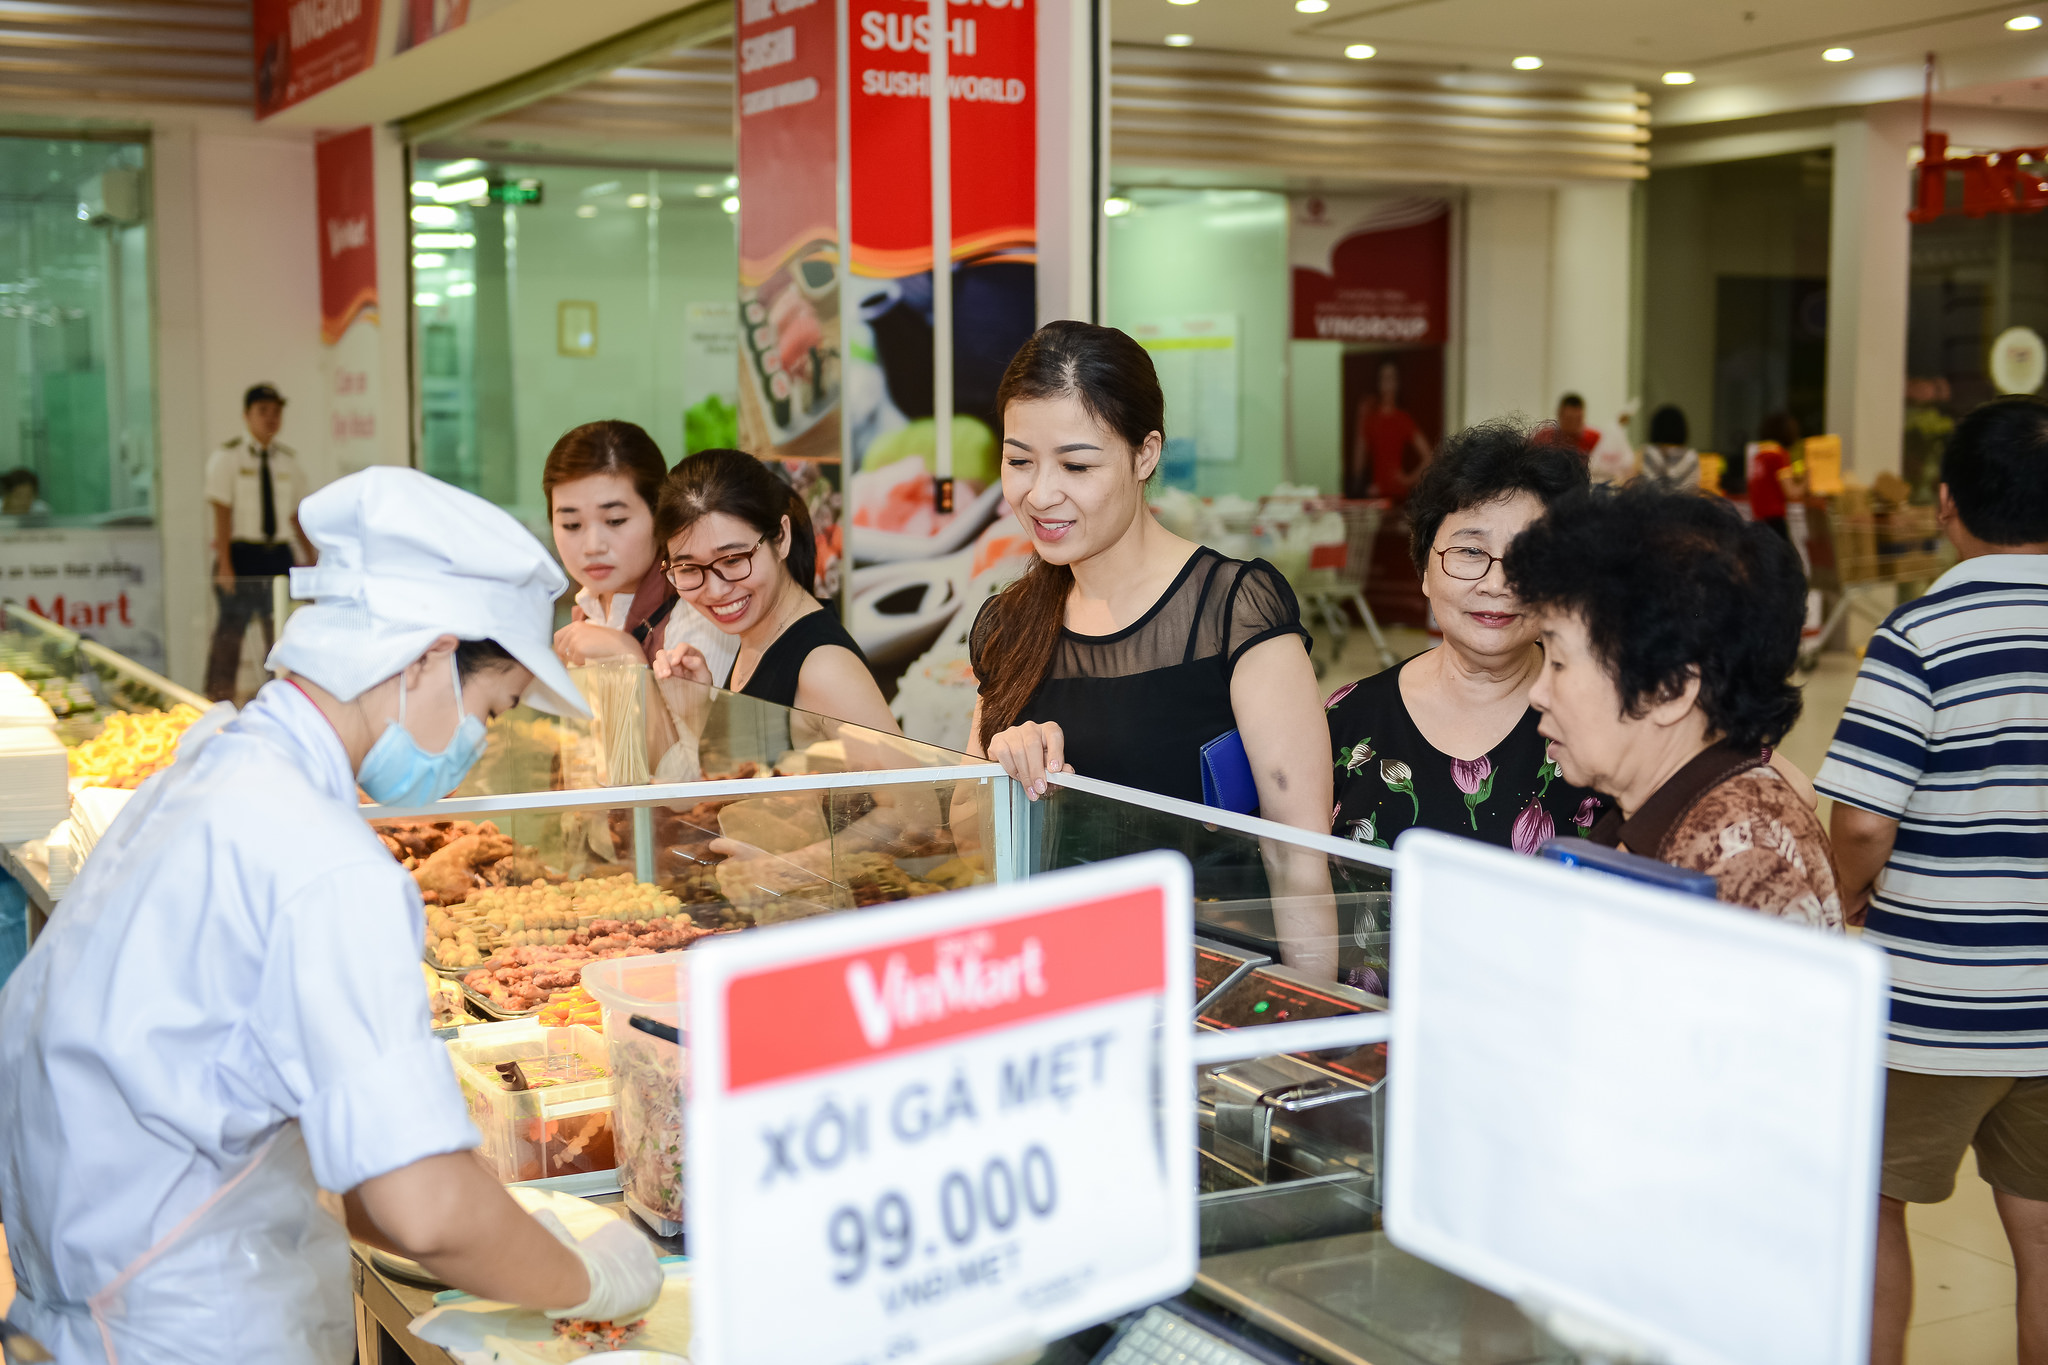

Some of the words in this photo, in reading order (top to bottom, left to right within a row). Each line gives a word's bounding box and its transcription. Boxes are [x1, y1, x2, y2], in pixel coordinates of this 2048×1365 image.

[860, 10, 977, 56] SUSHI
[846, 935, 1048, 1048] VinMart
[756, 1091, 872, 1192] XÔI
[999, 1030, 1117, 1112] MẸT
[827, 1143, 1058, 1286] 99.000
